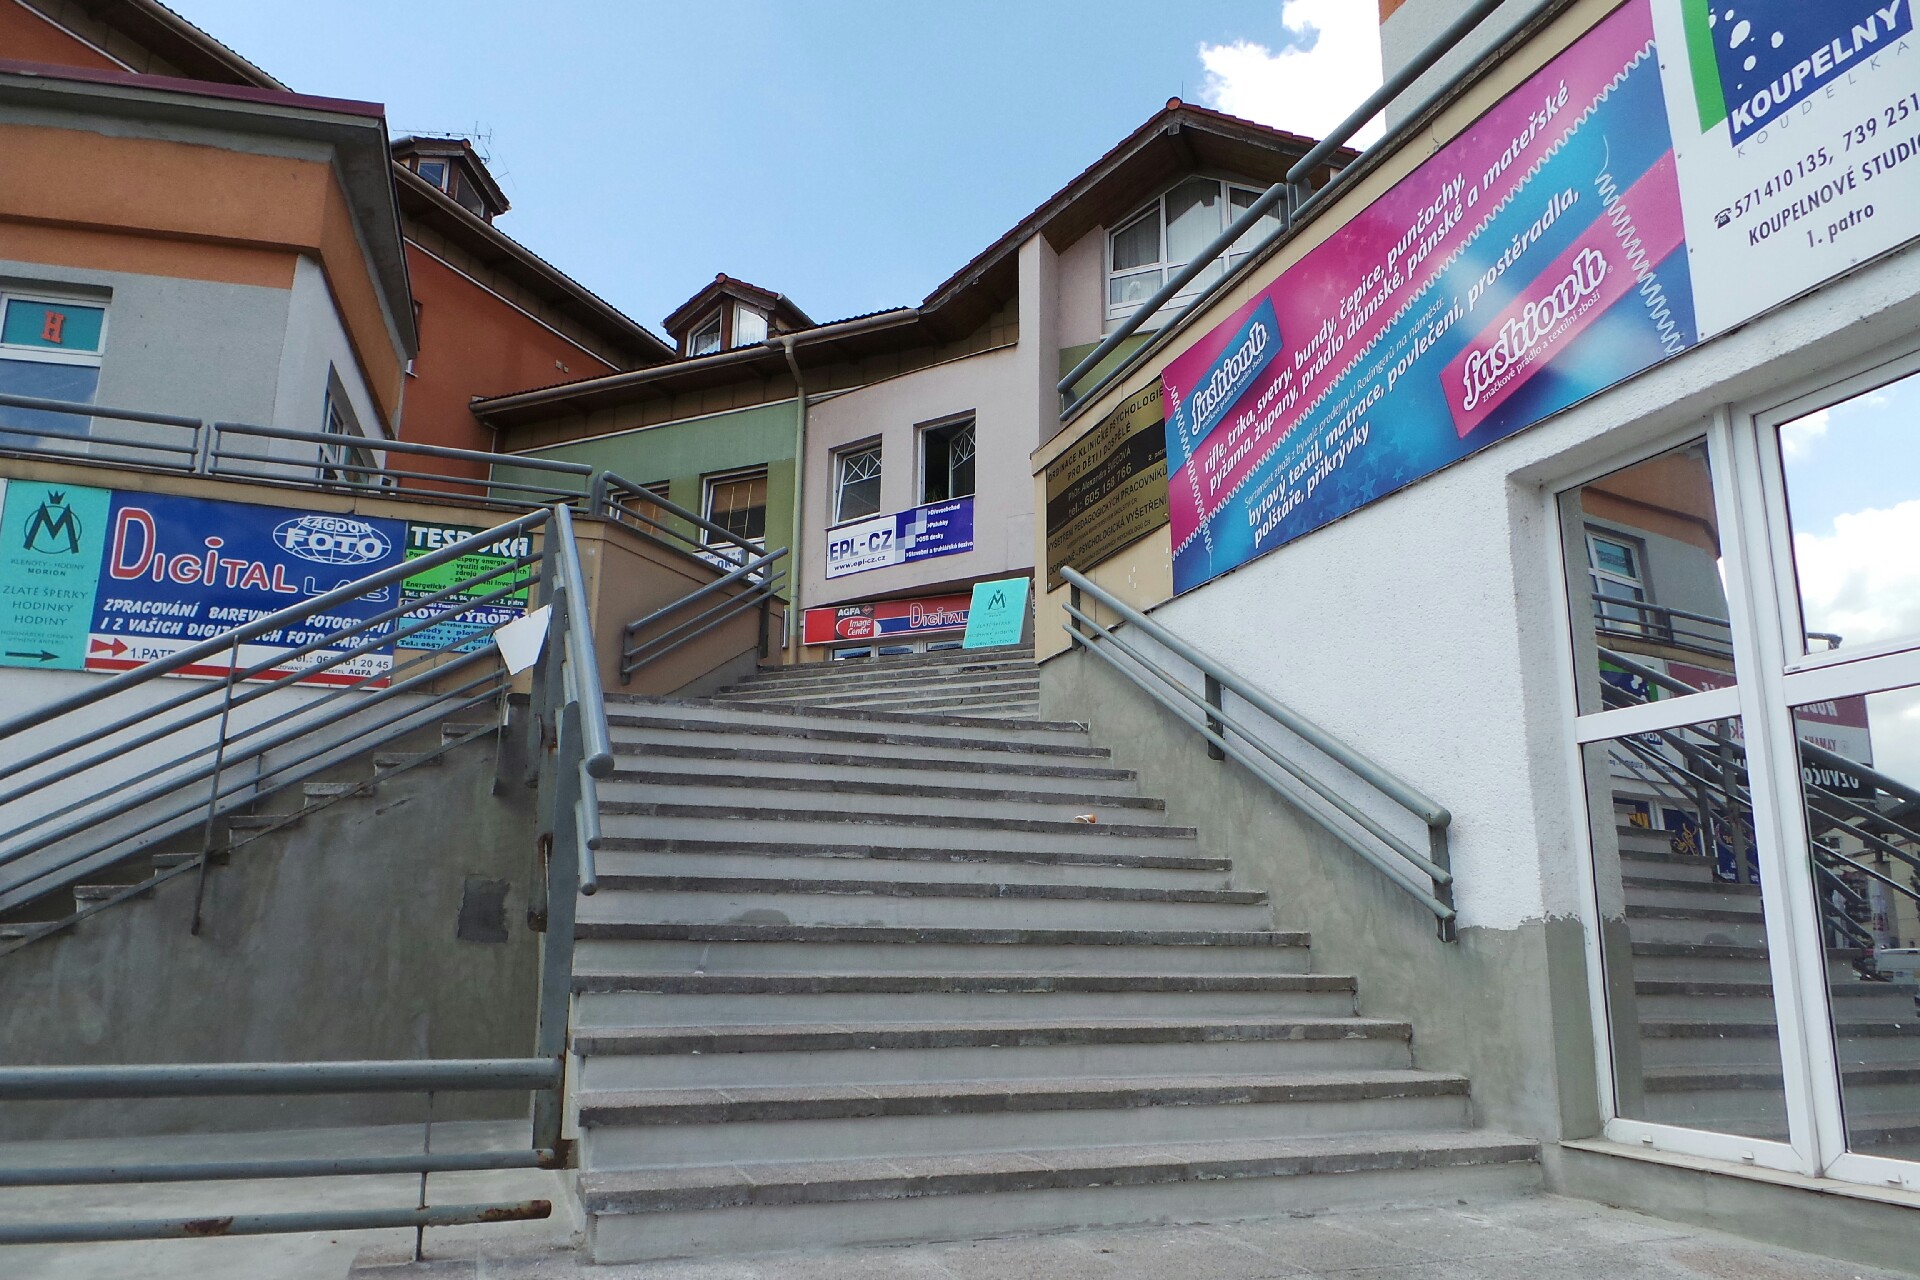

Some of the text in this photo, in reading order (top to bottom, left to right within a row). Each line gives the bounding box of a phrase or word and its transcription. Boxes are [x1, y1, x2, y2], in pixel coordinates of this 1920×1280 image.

[1731, 0, 1901, 134] KOUPELNY
[1796, 147, 1834, 178] 135,
[1842, 118, 1877, 152] 739
[1884, 93, 1920, 128] 251
[1749, 133, 1920, 246] KOUPELNOVÉ STUDI
[1806, 203, 1875, 248] 1. patro
[1210, 79, 1569, 496] pyžama, župany, prádlo dámské, pánské a mateřské
[1204, 172, 1465, 473] rifle, trika, svetry, bundy, čepice, punčochy,
[1248, 187, 1579, 527] bytový textil, matrace, povlečení, prostěradla,
[1482, 368, 1516, 403] značkové
[1515, 347, 1542, 374] prádlo
[1548, 312, 1578, 343] textilní
[1578, 288, 1601, 317] zboží
[1109, 386, 1164, 433] PSYCHOLOGIE
[1244, 473, 1274, 508] Sortiment
[1319, 394, 1350, 434] prodejny
[1396, 335, 1407, 353] na
[1067, 464, 1081, 480] PRO
[1084, 488, 1100, 506] 605
[1254, 421, 1369, 549] polštáře, přikrývky
[1126, 494, 1167, 524] VYŠETŘENÍ
[23, 501, 80, 554] M
[298, 515, 373, 533] LAGOON
[285, 527, 383, 559] FOTO
[28, 568, 66, 577] MORION
[834, 555, 886, 571] www.epl-cz.cz
[43, 585, 89, 599] ŠPERKY
[12, 600, 74, 612] HODINKY
[103, 598, 201, 618] ZPRACOVÁNÍ
[837, 607, 861, 617] AGFA
[14, 615, 68, 626] HODINY
[128, 617, 183, 635] VAŠICH
[847, 627, 871, 636] Center
[848, 619, 871, 629] Image
[360, 659, 373, 668] 20
[376, 661, 389, 669] 45
